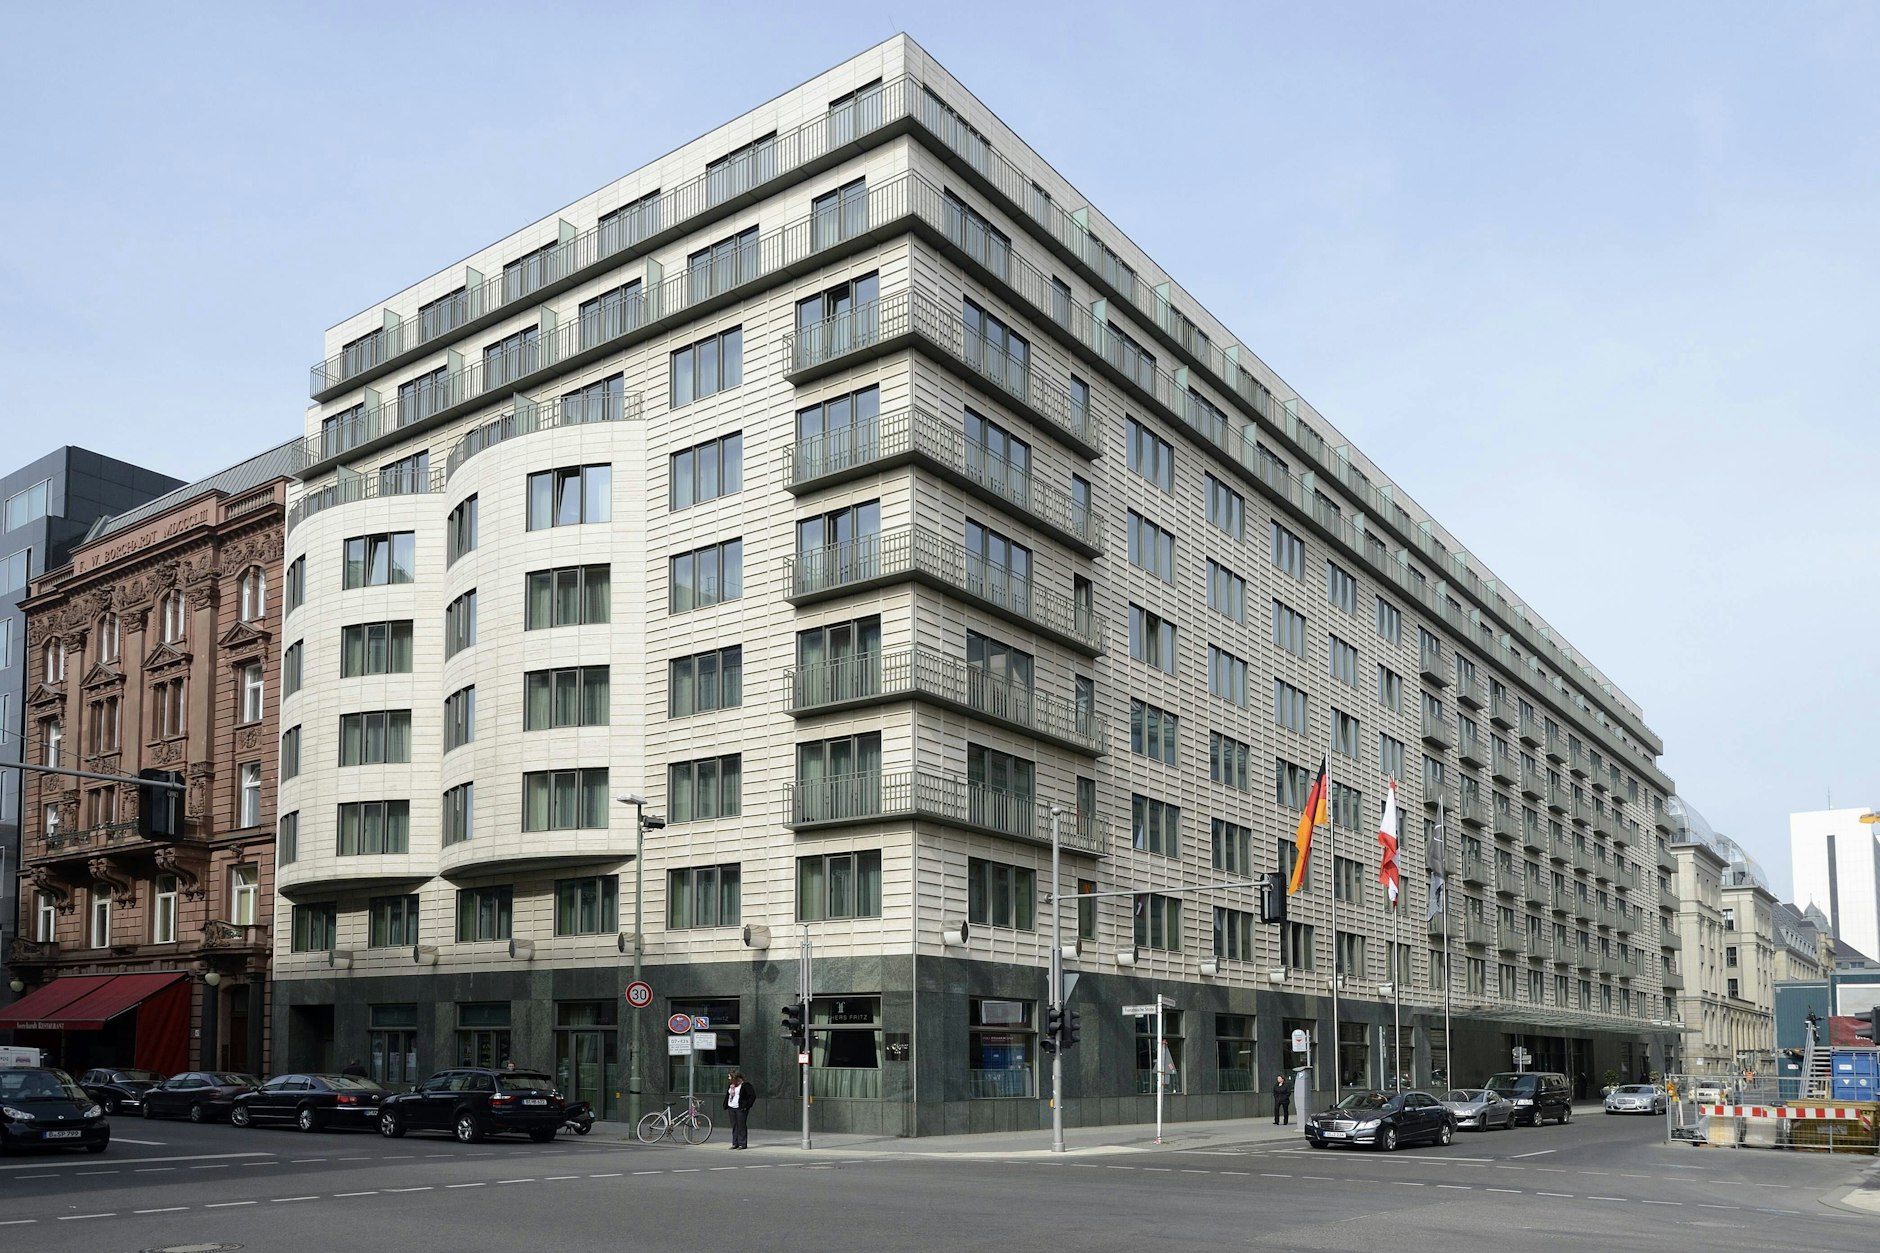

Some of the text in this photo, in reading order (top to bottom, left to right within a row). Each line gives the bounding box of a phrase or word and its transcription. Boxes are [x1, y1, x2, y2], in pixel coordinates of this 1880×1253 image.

[104, 530, 158, 563] BORCHARDT
[163, 509, 209, 538] MDCCCLIII
[632, 989, 647, 1000] 30
